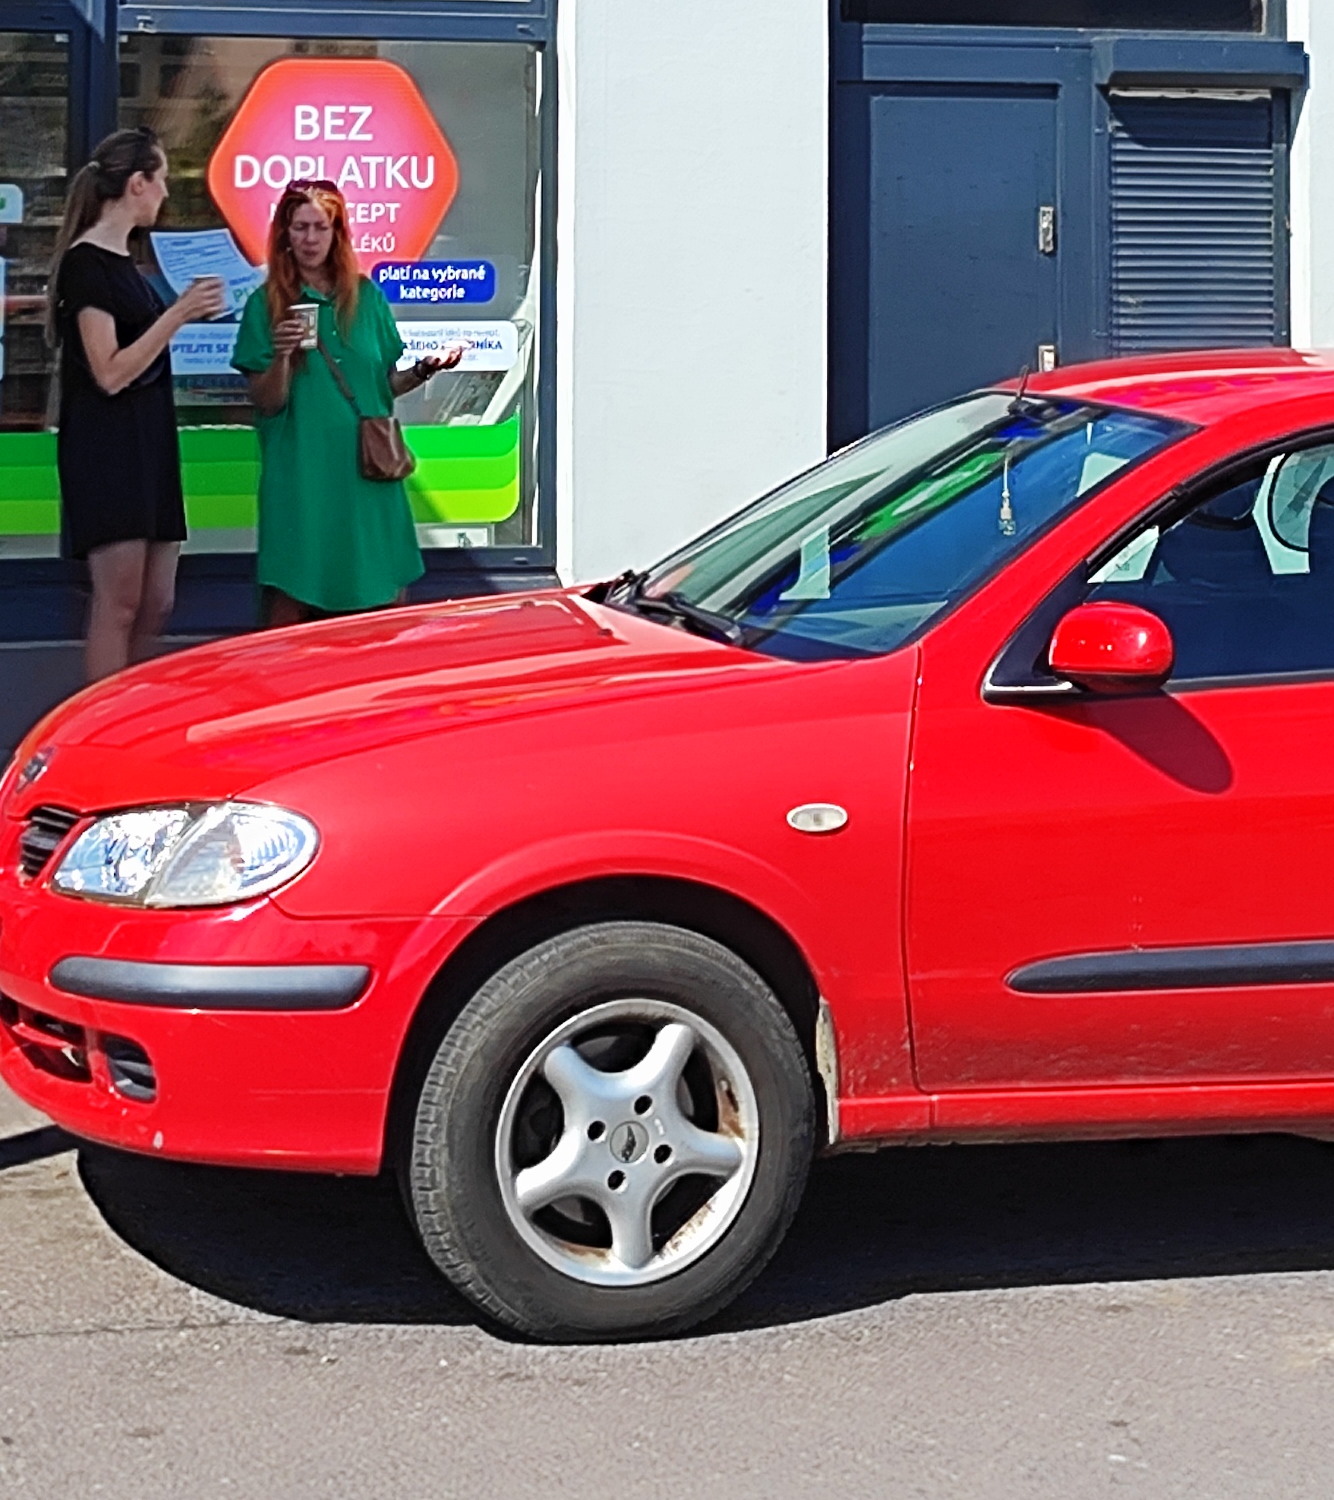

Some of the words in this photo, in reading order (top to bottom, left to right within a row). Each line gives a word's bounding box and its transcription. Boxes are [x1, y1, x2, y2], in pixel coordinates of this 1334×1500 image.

[294, 104, 373, 141] BEZ
[234, 154, 435, 189] DOPLATKU
[347, 202, 401, 223] CEPT
[379, 265, 411, 283] platí
[412, 269, 430, 280] na
[431, 264, 486, 283] vybrané
[399, 284, 466, 302] kategorie
